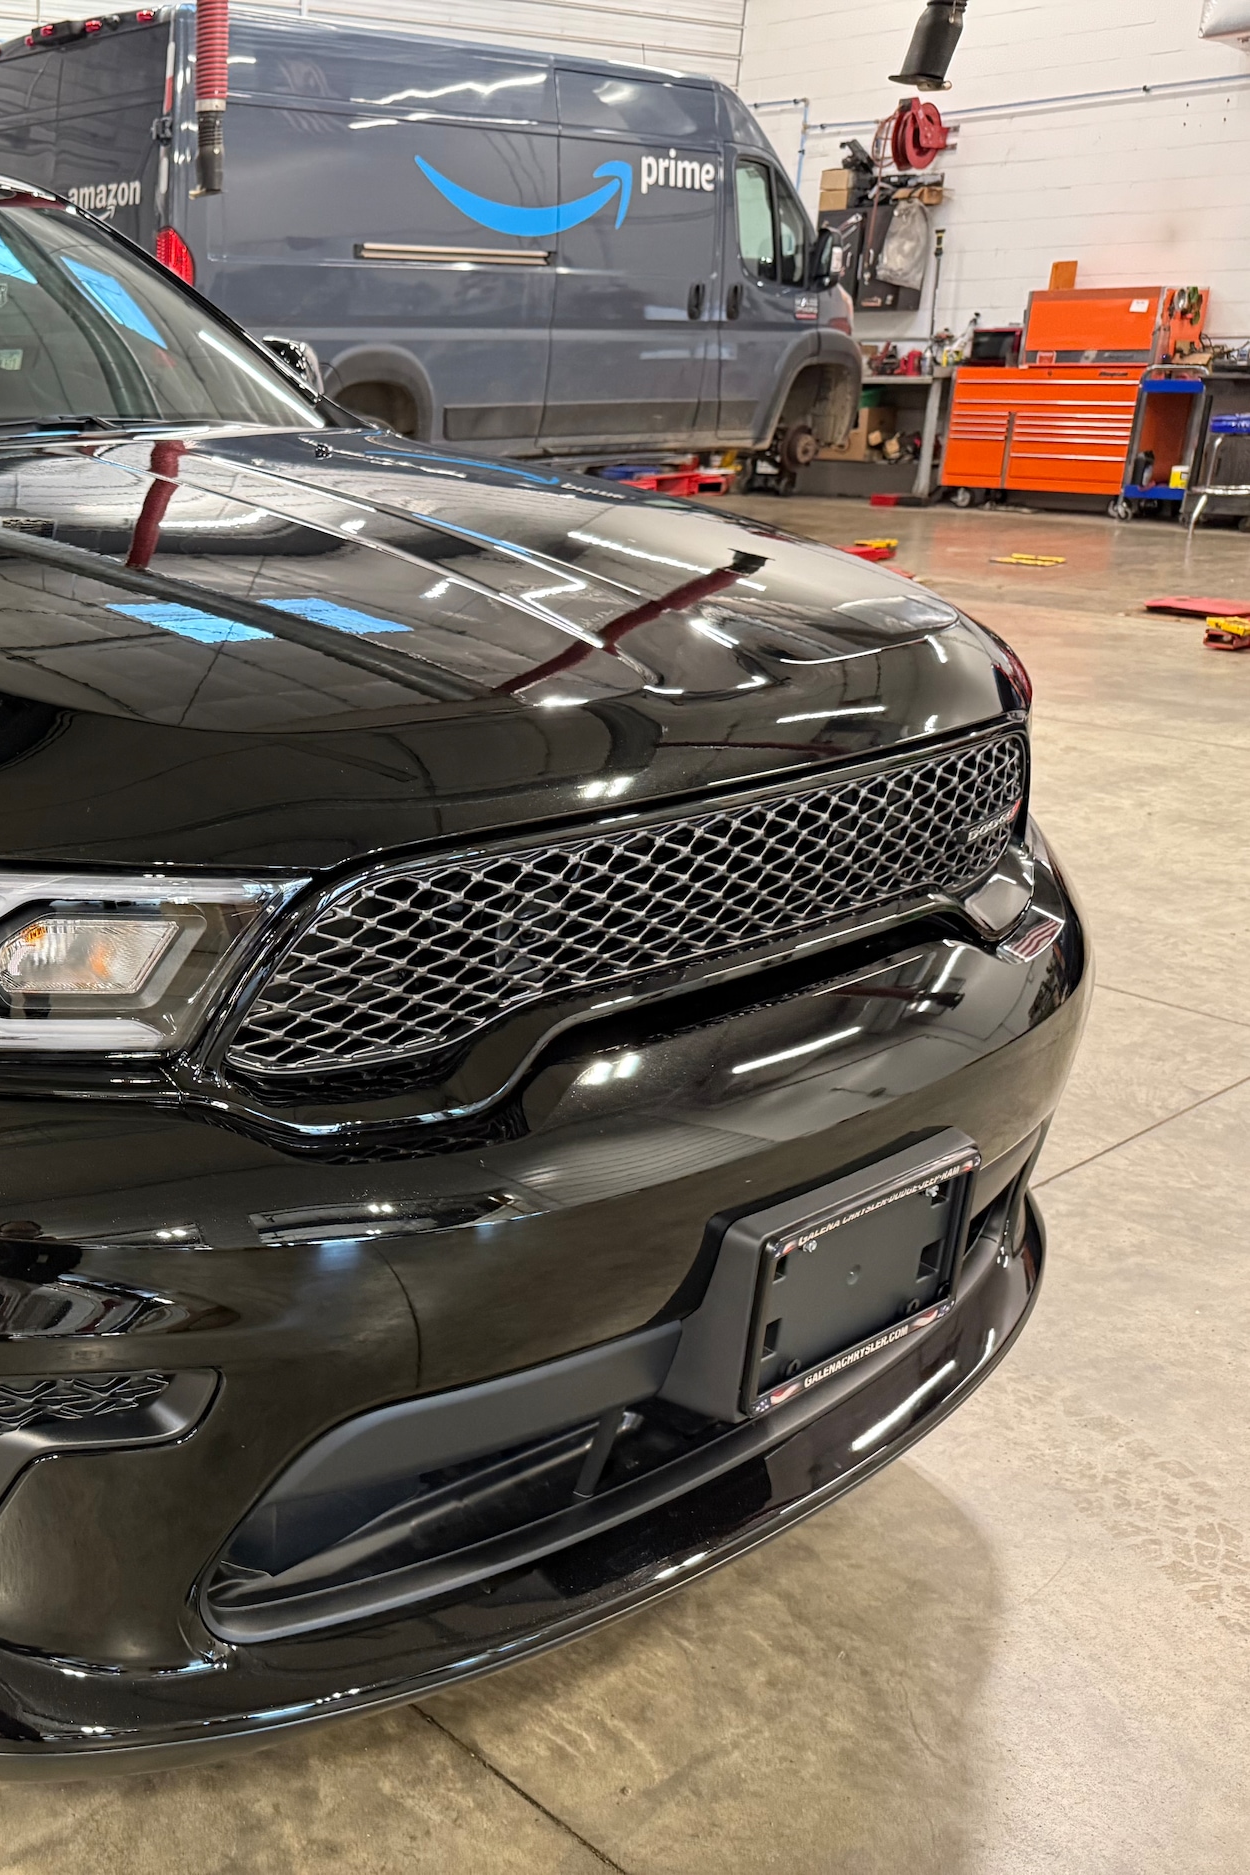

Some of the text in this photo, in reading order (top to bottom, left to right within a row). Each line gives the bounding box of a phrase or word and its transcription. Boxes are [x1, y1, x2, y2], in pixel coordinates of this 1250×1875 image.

[640, 148, 715, 194] prime
[67, 180, 141, 210] amazon
[798, 1218, 841, 1247] GALENA
[803, 1324, 910, 1389] GALENACHRYSLER.COM
